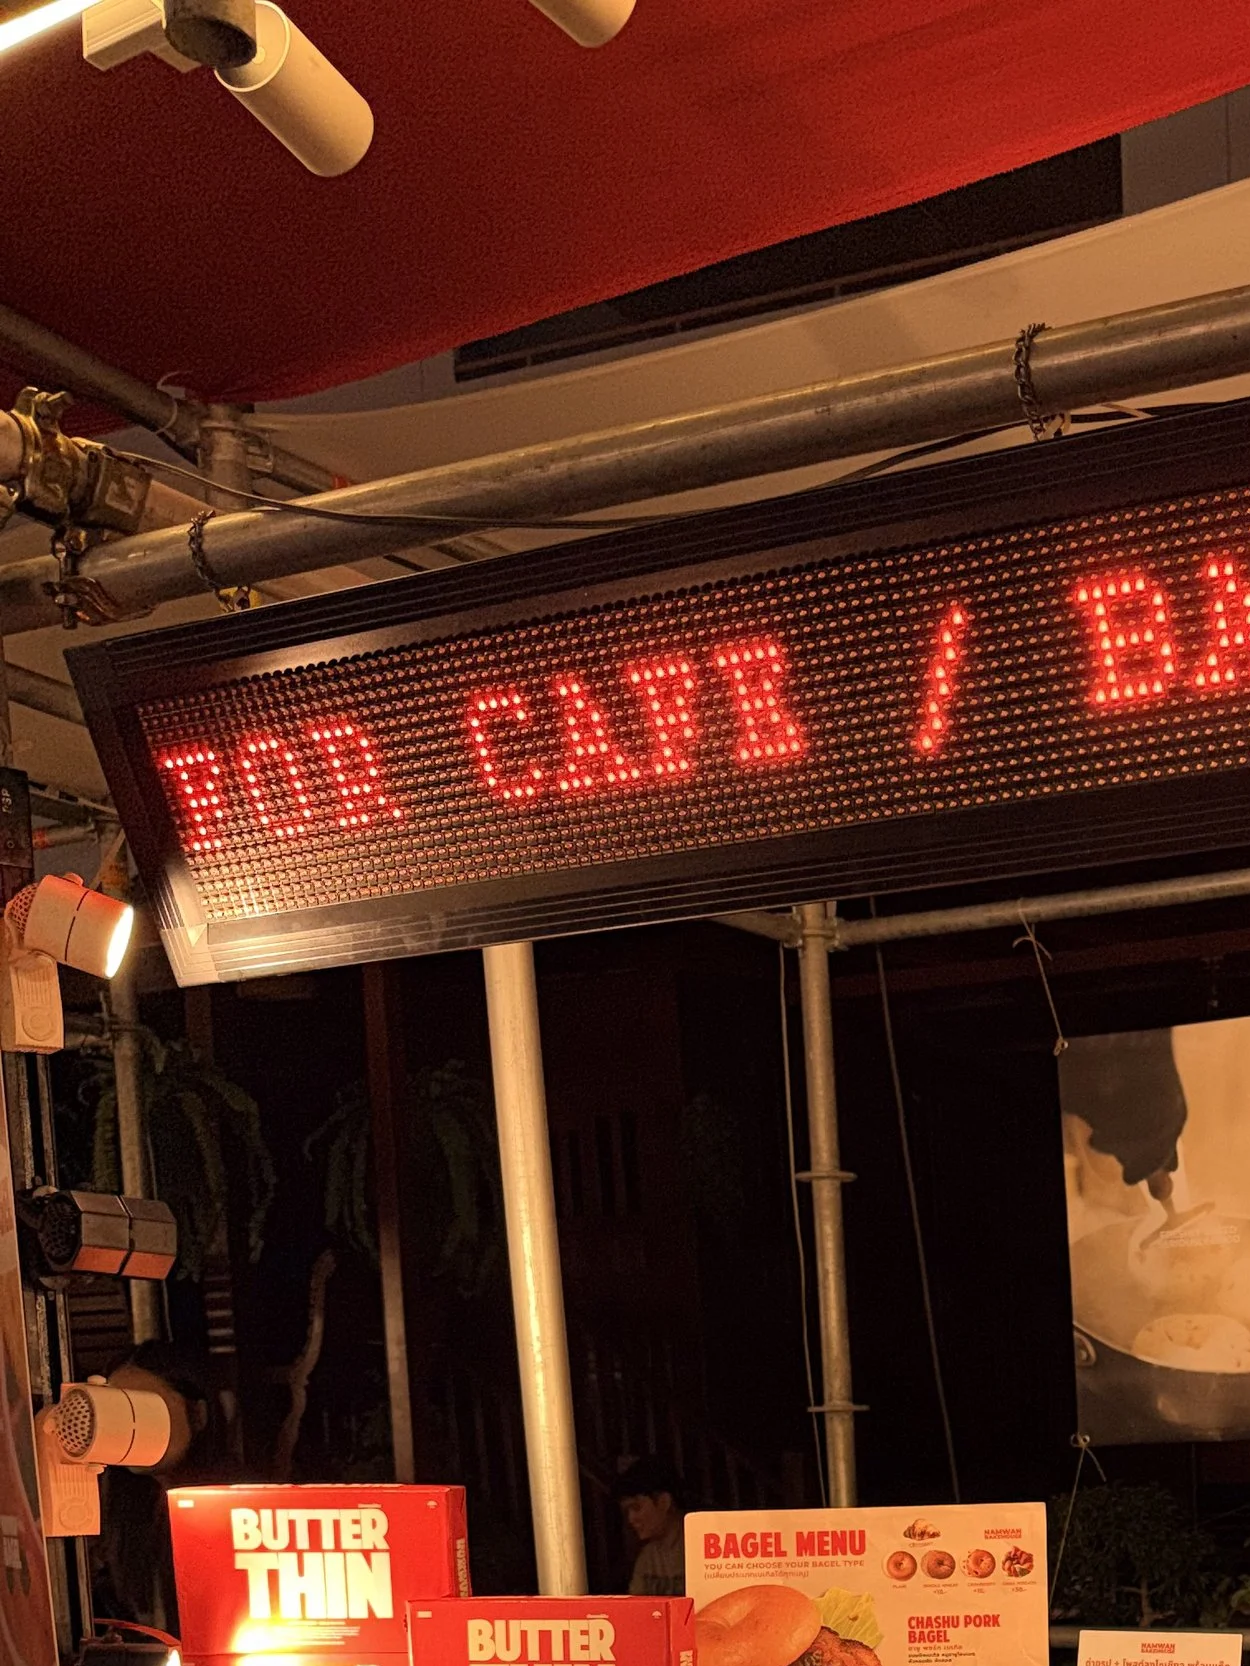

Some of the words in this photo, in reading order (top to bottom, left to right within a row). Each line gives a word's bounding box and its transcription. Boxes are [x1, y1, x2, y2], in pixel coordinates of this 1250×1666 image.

[468, 638, 806, 800] CAFE
[230, 1507, 390, 1551] BUTTER
[704, 1532, 787, 1559] BAGEL
[796, 1529, 866, 1557] MENU
[725, 1562, 744, 1570] CAN
[745, 1561, 783, 1569] CHOOSE
[842, 1559, 864, 1567] TYPE
[234, 1551, 393, 1619] THIN
[467, 1618, 616, 1662] BUTTER
[908, 1615, 960, 1629] CHASHU
[964, 1614, 1000, 1628] PORK
[908, 1630, 950, 1643] BAGEL
